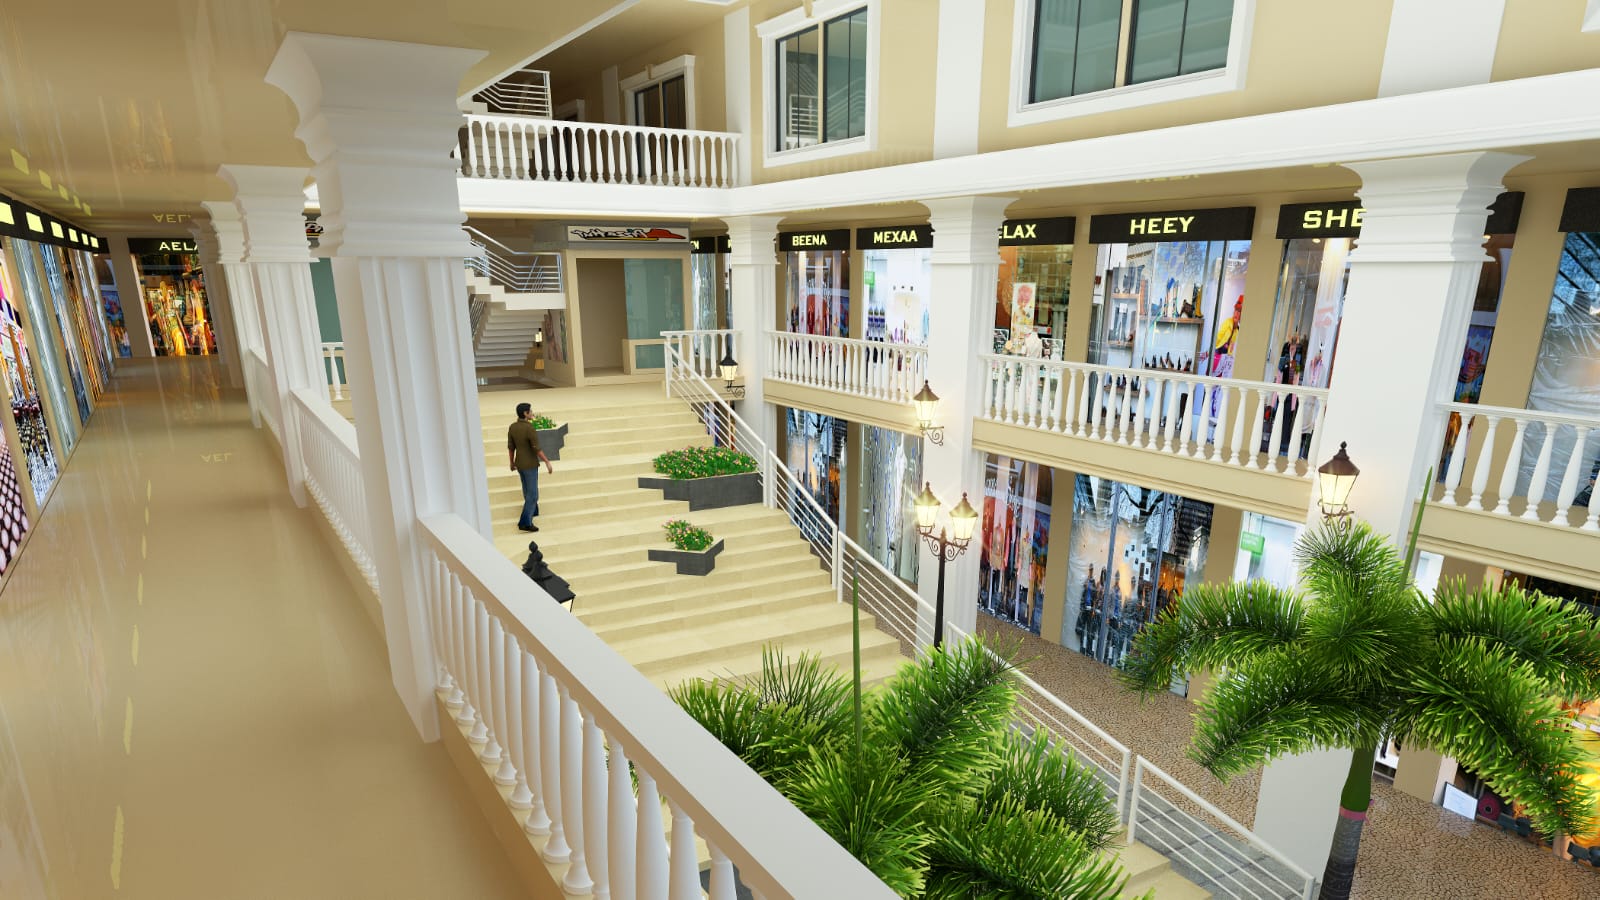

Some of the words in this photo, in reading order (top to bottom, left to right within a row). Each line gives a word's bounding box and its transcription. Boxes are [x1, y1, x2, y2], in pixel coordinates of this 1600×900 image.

[998, 224, 1037, 239] LAX
[1129, 216, 1195, 235] HEEY
[792, 234, 828, 247] BEENA
[873, 230, 918, 244] MEXAA
